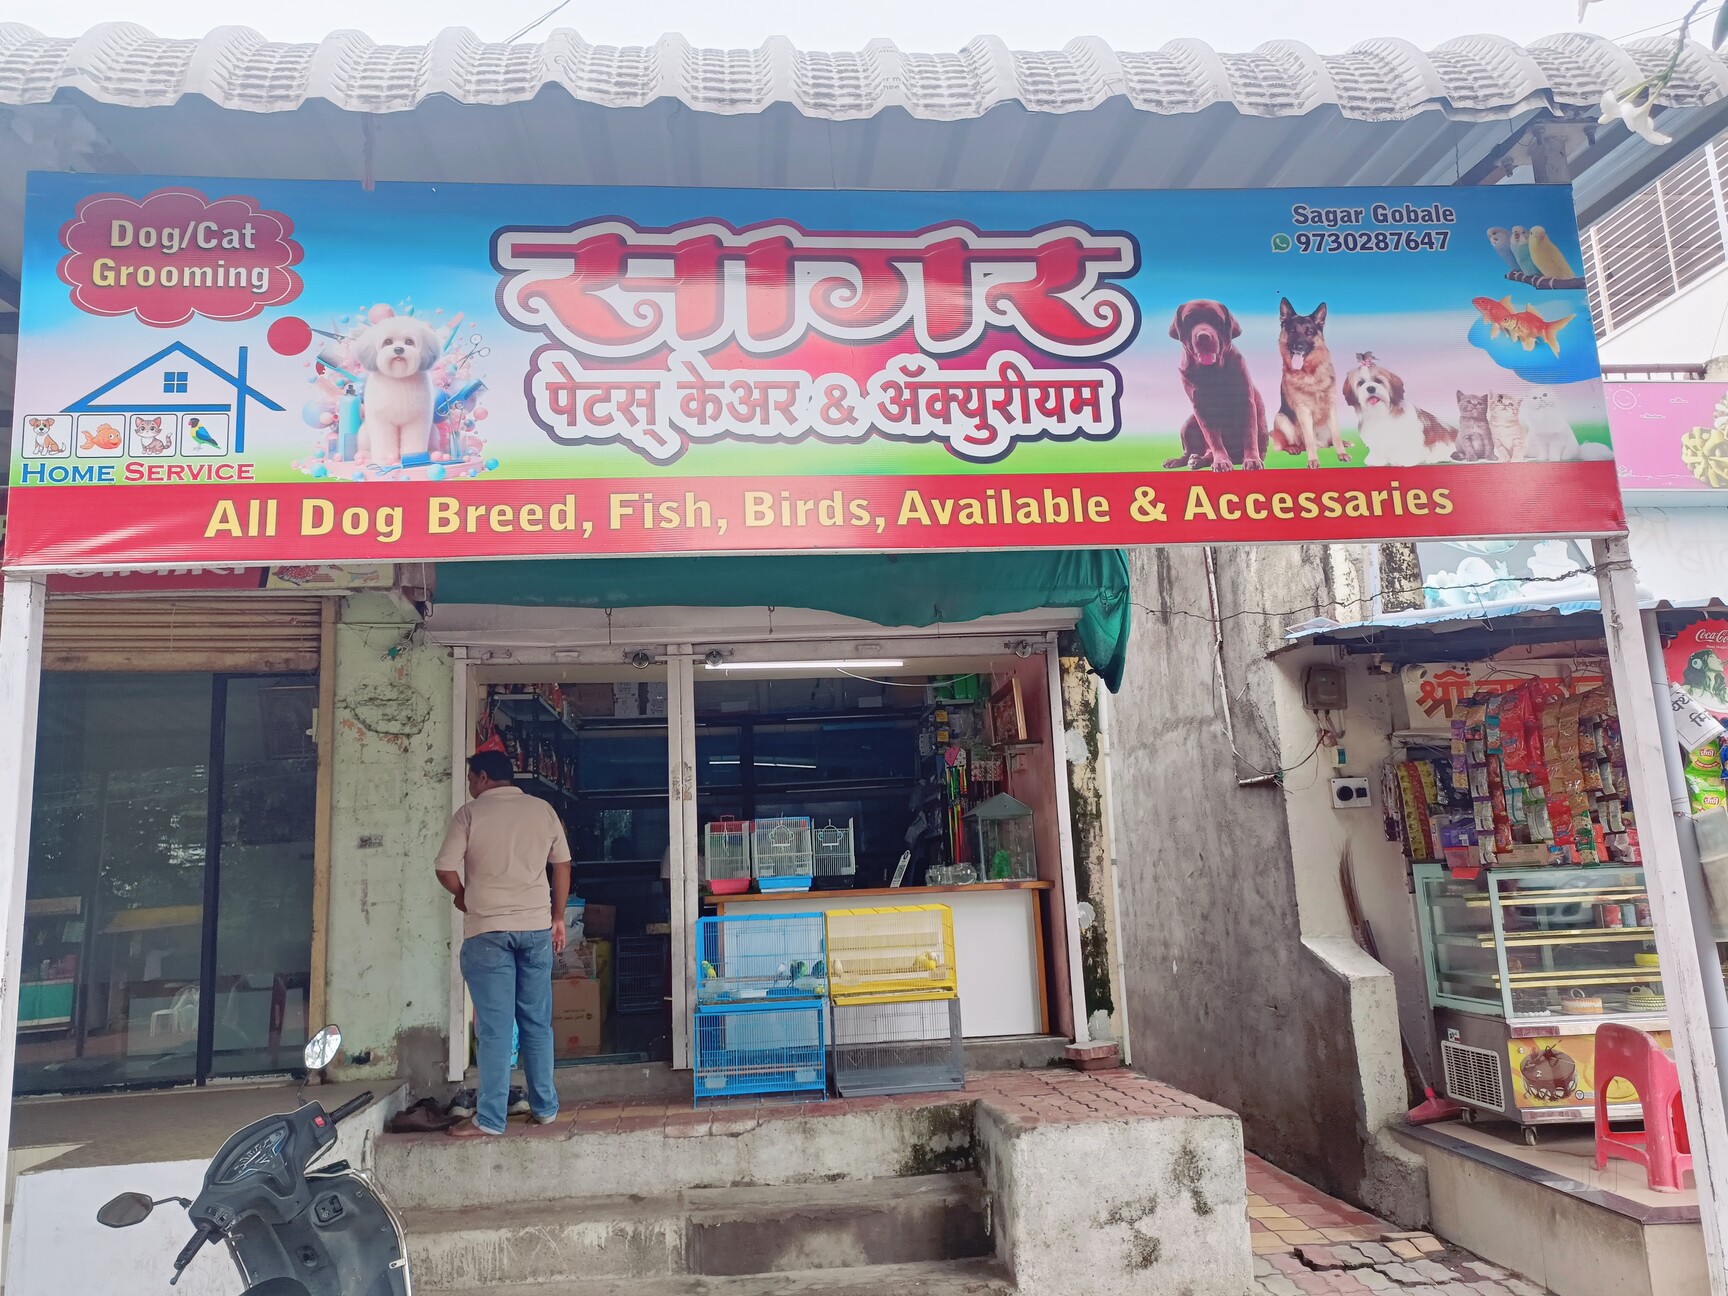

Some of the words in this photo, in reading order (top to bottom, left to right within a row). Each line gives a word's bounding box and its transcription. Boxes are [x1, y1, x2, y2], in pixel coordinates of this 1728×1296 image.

[1292, 204, 1364, 228] Sagar
[1372, 203, 1456, 224] Gobale
[110, 219, 256, 254] Dog/Cat
[1295, 230, 1450, 253] 9730287647
[92, 258, 270, 293] Grooming
[506, 230, 1126, 348] सागर
[545, 361, 667, 447] पेटस्
[676, 361, 800, 427] केअर
[820, 383, 858, 426] &
[203, 498, 278, 538] All
[300, 497, 404, 543] Dog
[428, 493, 593, 539] Breed,
[608, 490, 728, 535] Fish,
[745, 490, 886, 534] Birds,
[897, 487, 1111, 526] Available
[1129, 485, 1167, 523] &
[1183, 480, 1454, 521] Accessaries
